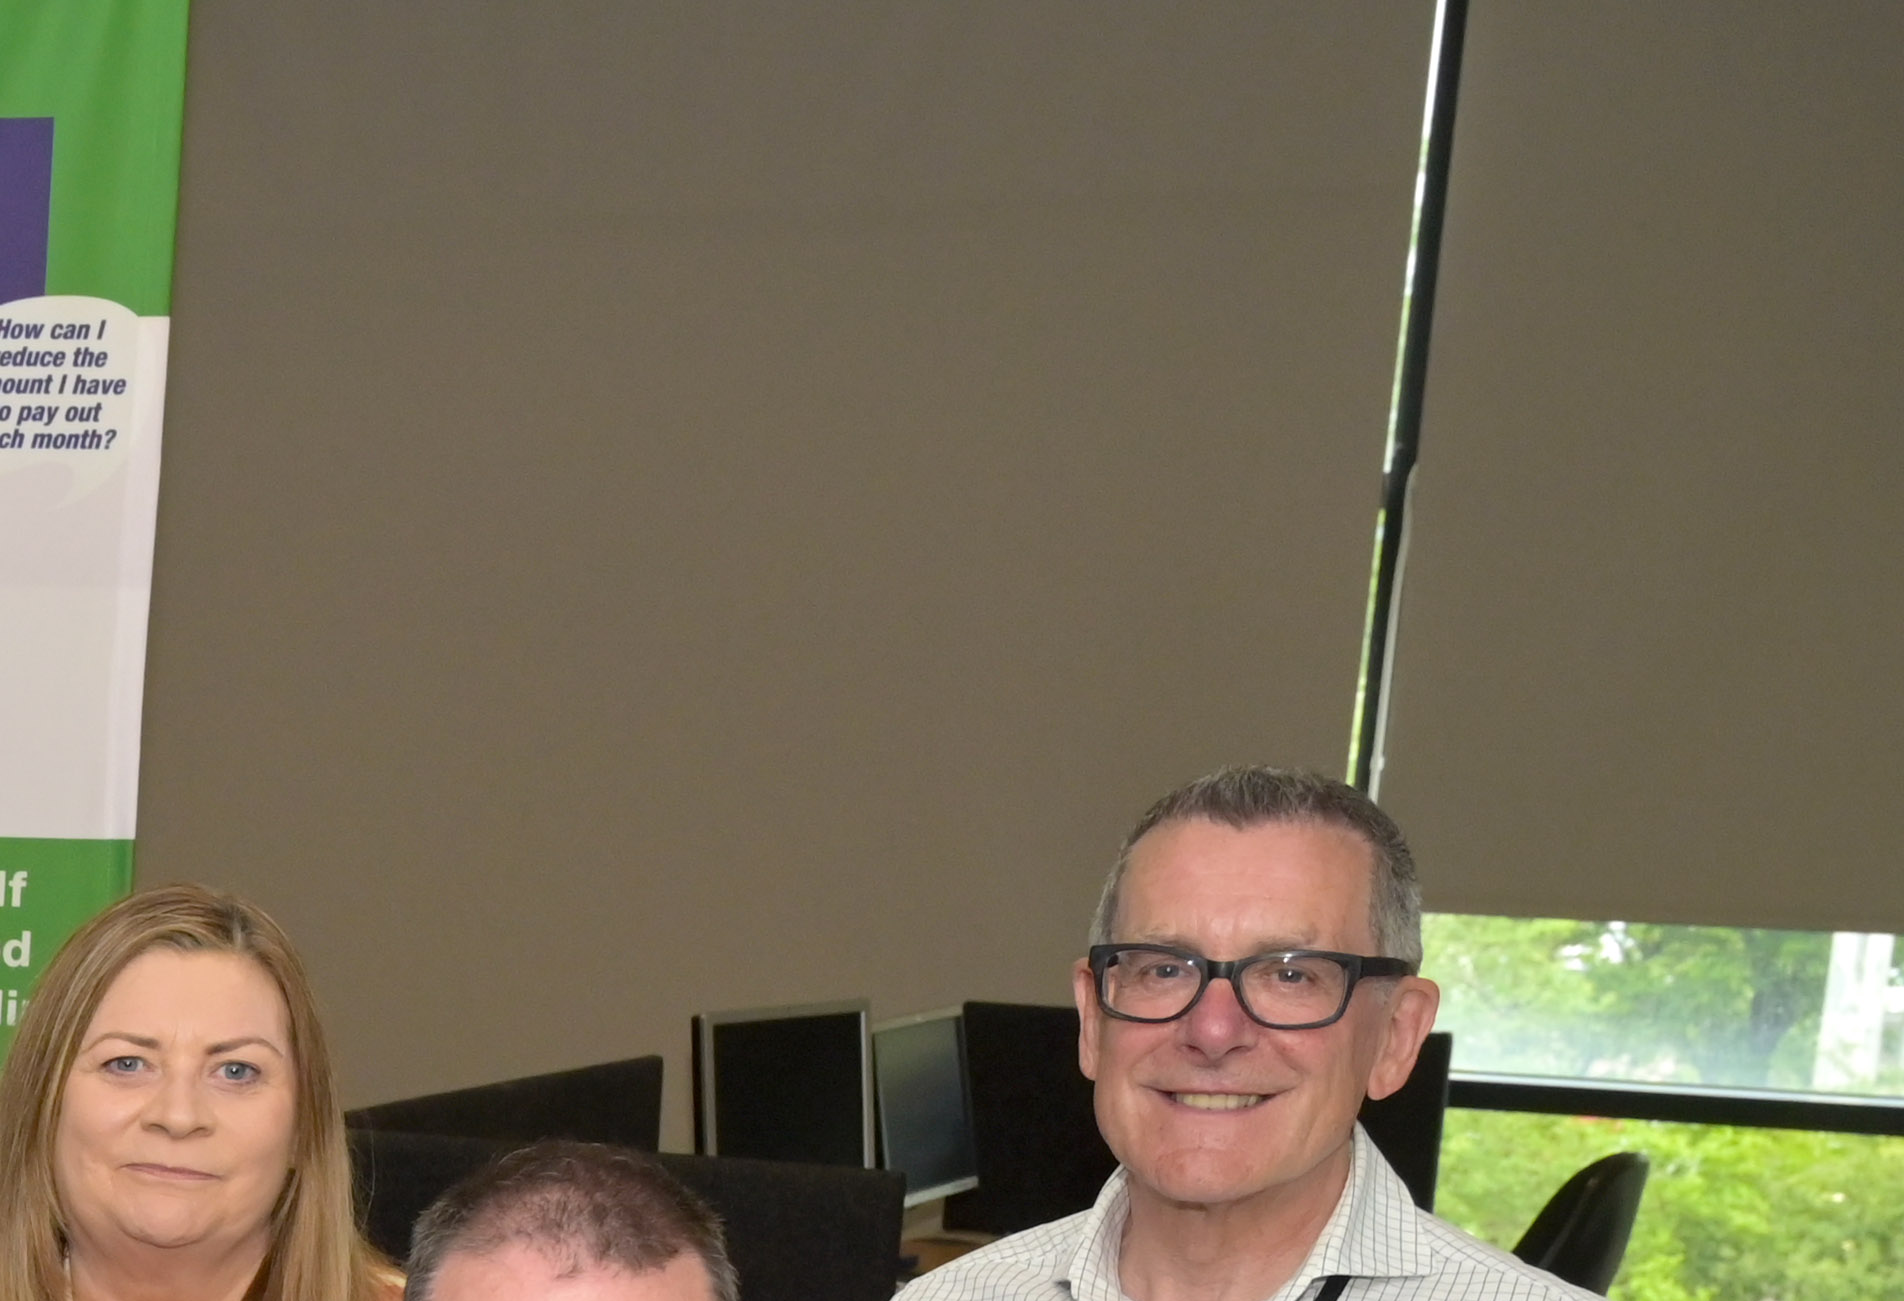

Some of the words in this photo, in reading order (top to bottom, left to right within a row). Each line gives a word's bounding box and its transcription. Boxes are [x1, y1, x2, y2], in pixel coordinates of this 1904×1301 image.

[50, 324, 90, 340] can
[97, 319, 106, 340] I
[73, 347, 108, 367] the
[58, 375, 67, 394] I
[72, 375, 127, 395] have
[17, 405, 59, 426] pay
[65, 403, 102, 422] out
[31, 429, 117, 450] month?
